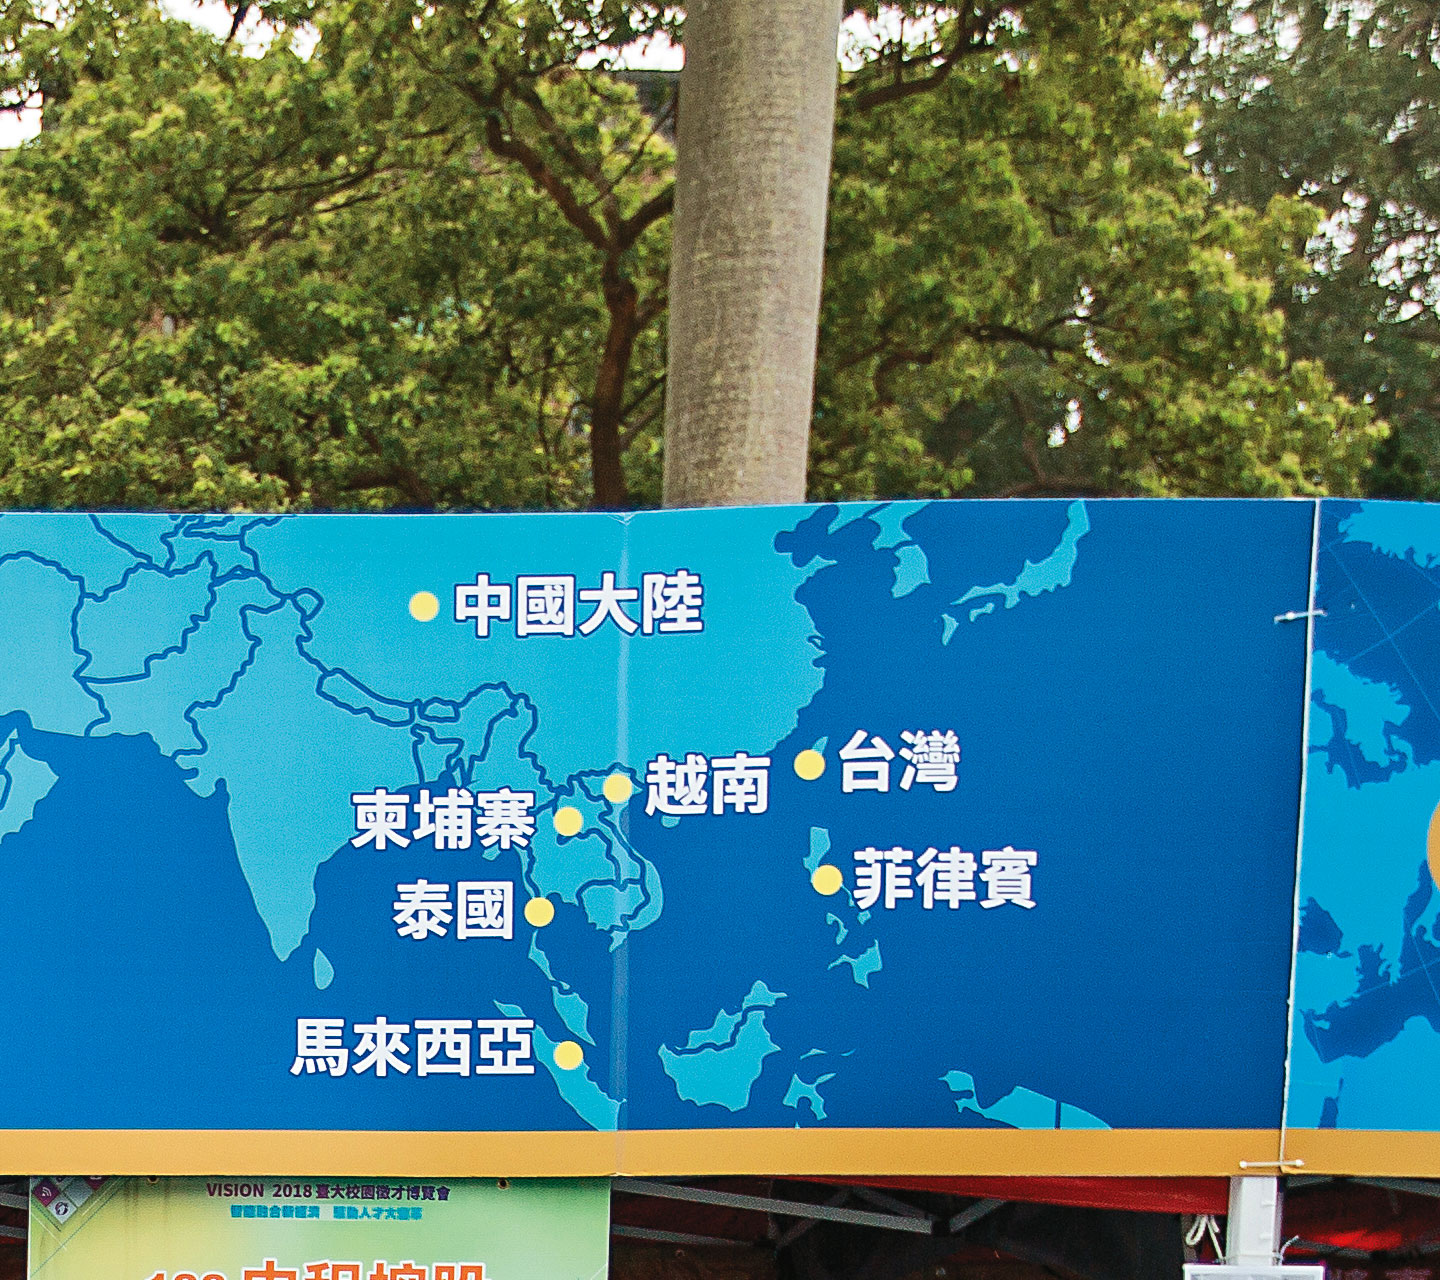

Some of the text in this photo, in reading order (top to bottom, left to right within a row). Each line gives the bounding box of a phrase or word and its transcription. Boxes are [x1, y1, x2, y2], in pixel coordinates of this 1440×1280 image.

[454, 570, 704, 637] 中國大陸
[645, 753, 770, 818] 越南
[839, 730, 961, 794] 台灣
[351, 789, 535, 851] 柬埔寨
[393, 879, 514, 941] 泰國
[853, 847, 1038, 911] 菲律賓
[290, 1018, 535, 1078] 馬來西亞
[207, 1183, 265, 1198] VISION
